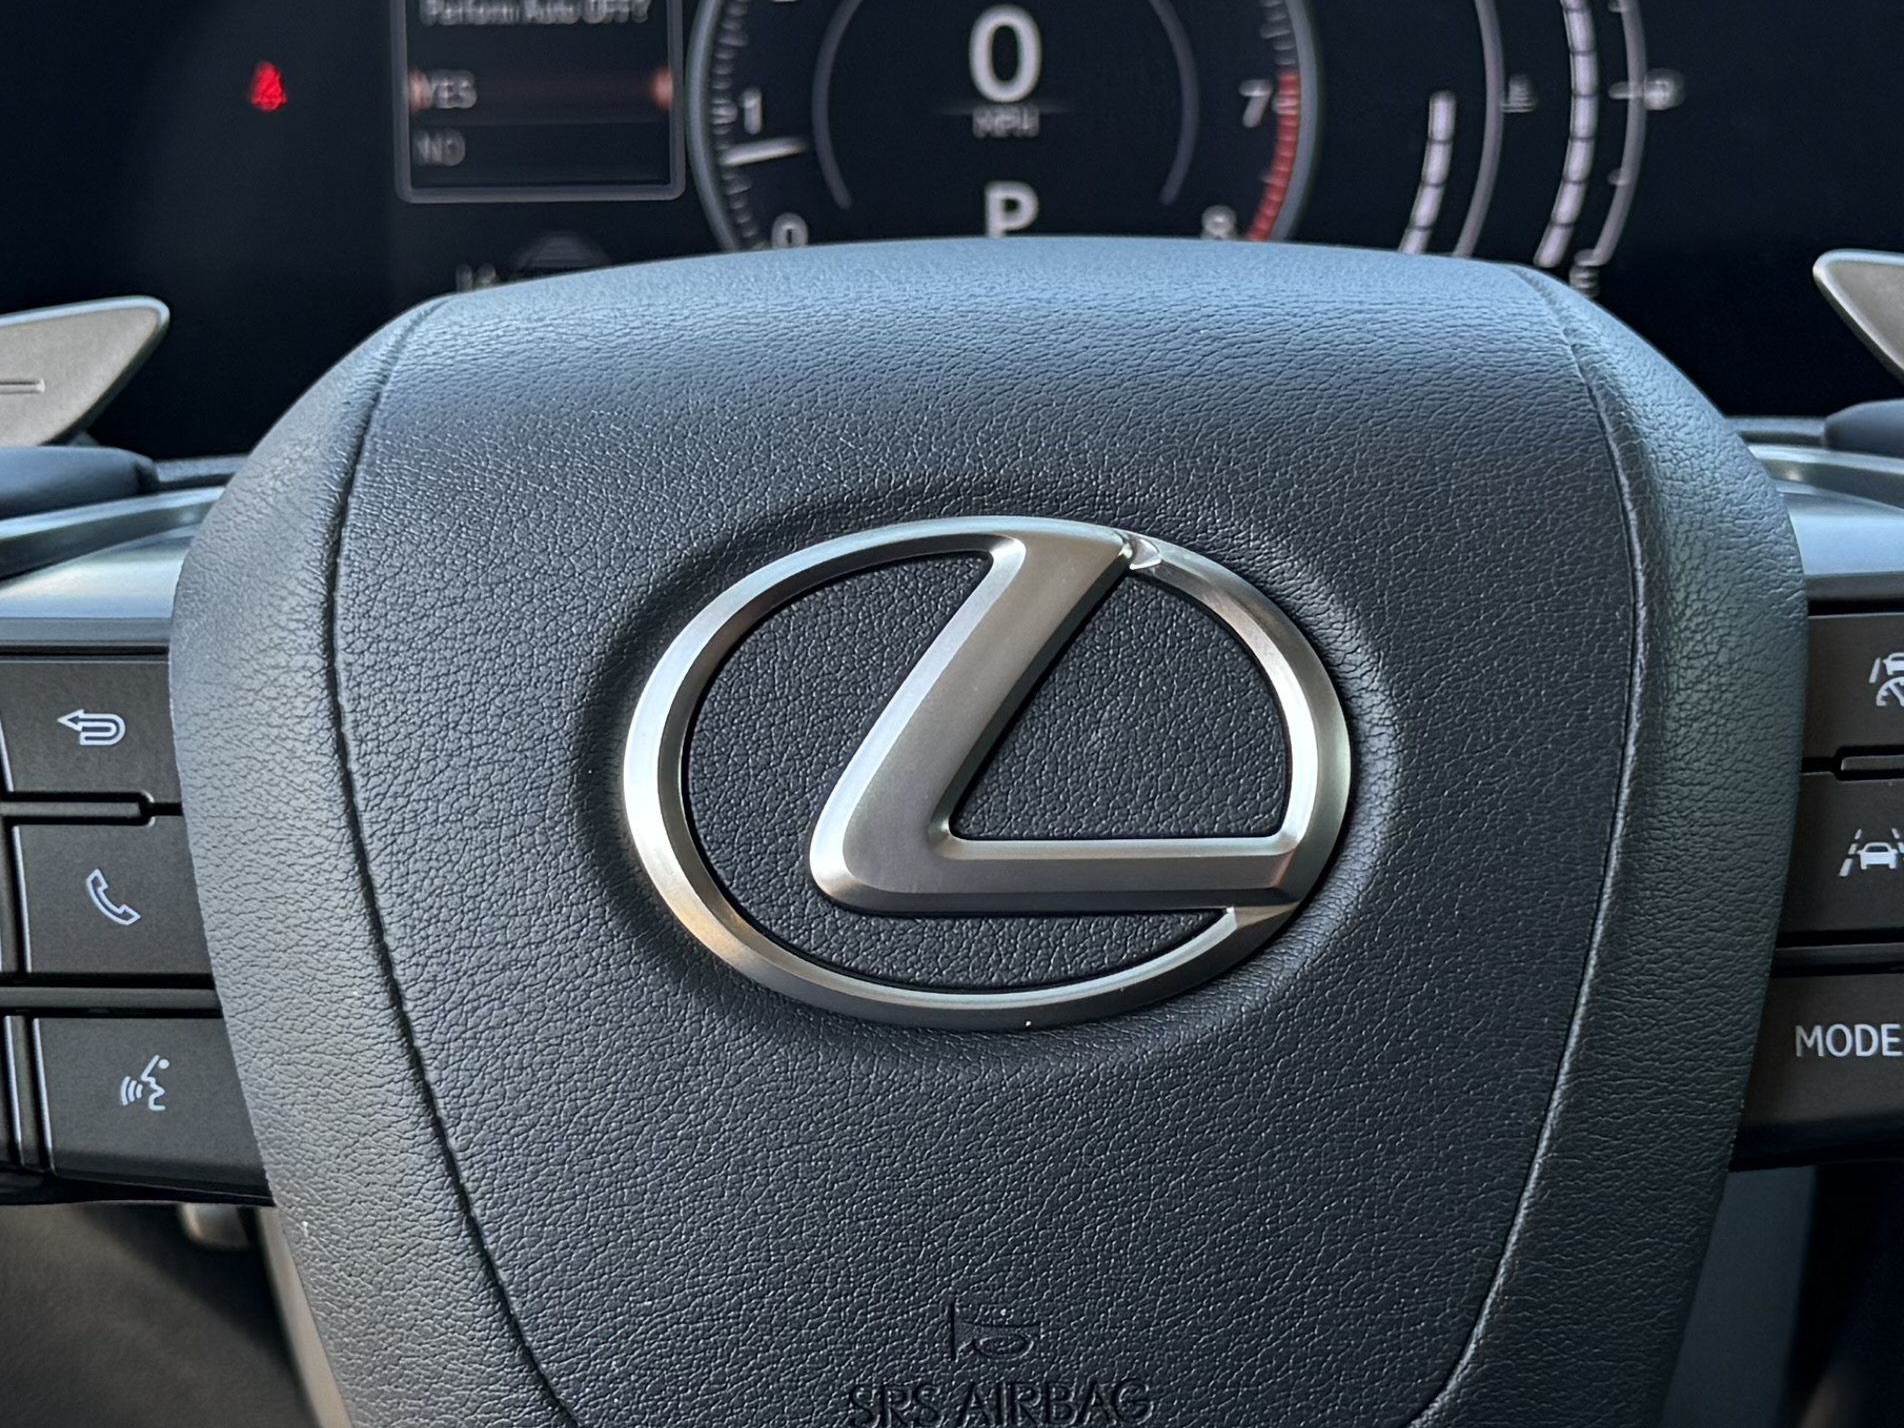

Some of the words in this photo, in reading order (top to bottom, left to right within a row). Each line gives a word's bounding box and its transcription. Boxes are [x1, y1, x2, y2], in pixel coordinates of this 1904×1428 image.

[968, 3, 1041, 103] 0
[739, 86, 763, 134] 1
[1240, 79, 1272, 128] 7
[985, 181, 1038, 238] P
[1795, 1023, 1904, 1058] MODE
[848, 1380, 943, 1428] SRS
[957, 1377, 1154, 1428] AIRBAG
